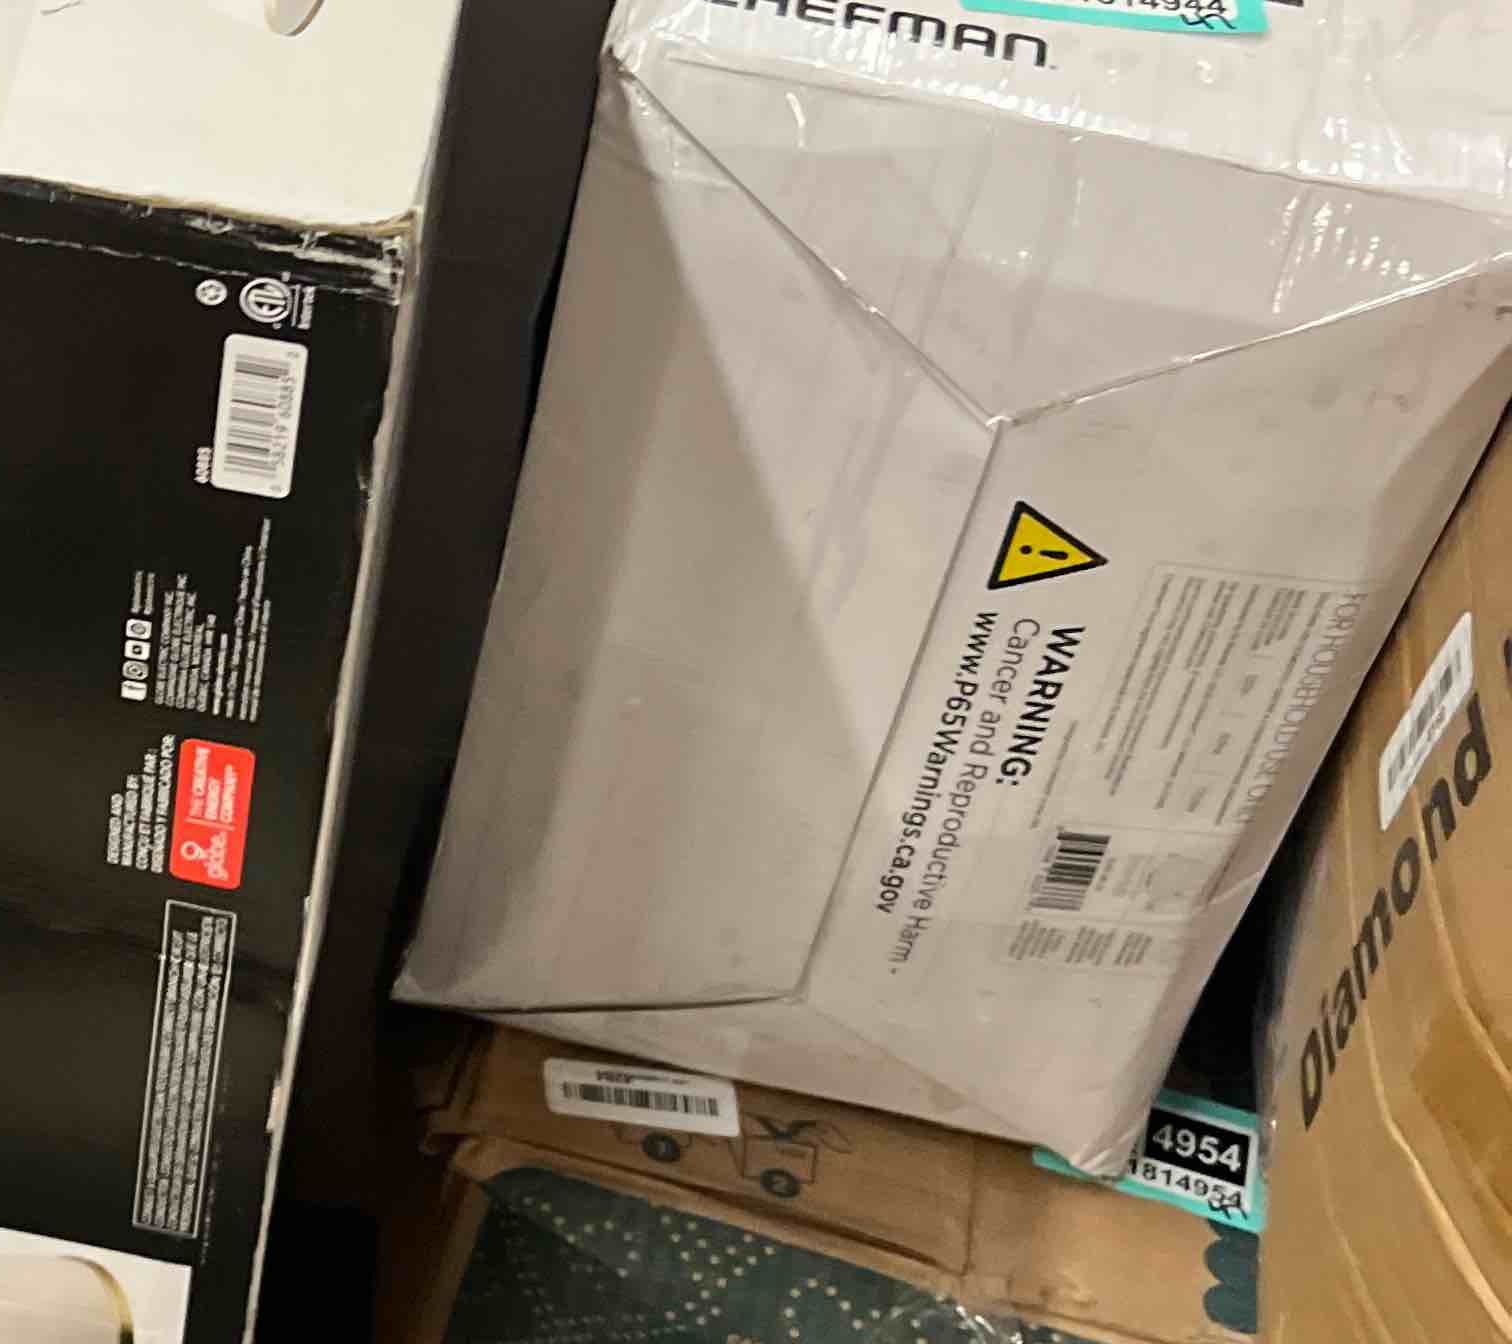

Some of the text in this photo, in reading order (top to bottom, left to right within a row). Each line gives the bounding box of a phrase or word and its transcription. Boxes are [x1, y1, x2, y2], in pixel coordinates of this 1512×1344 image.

[969, 710, 1001, 757] and
[989, 618, 1041, 706] Cancer
[995, 625, 1087, 786] WARNING:
[875, 612, 999, 914] www.P65Warnings.ca.gov
[912, 762, 989, 911] Reproductive
[1299, 691, 1492, 1131] Diamond
[1152, 1122, 1242, 1173] 4954
